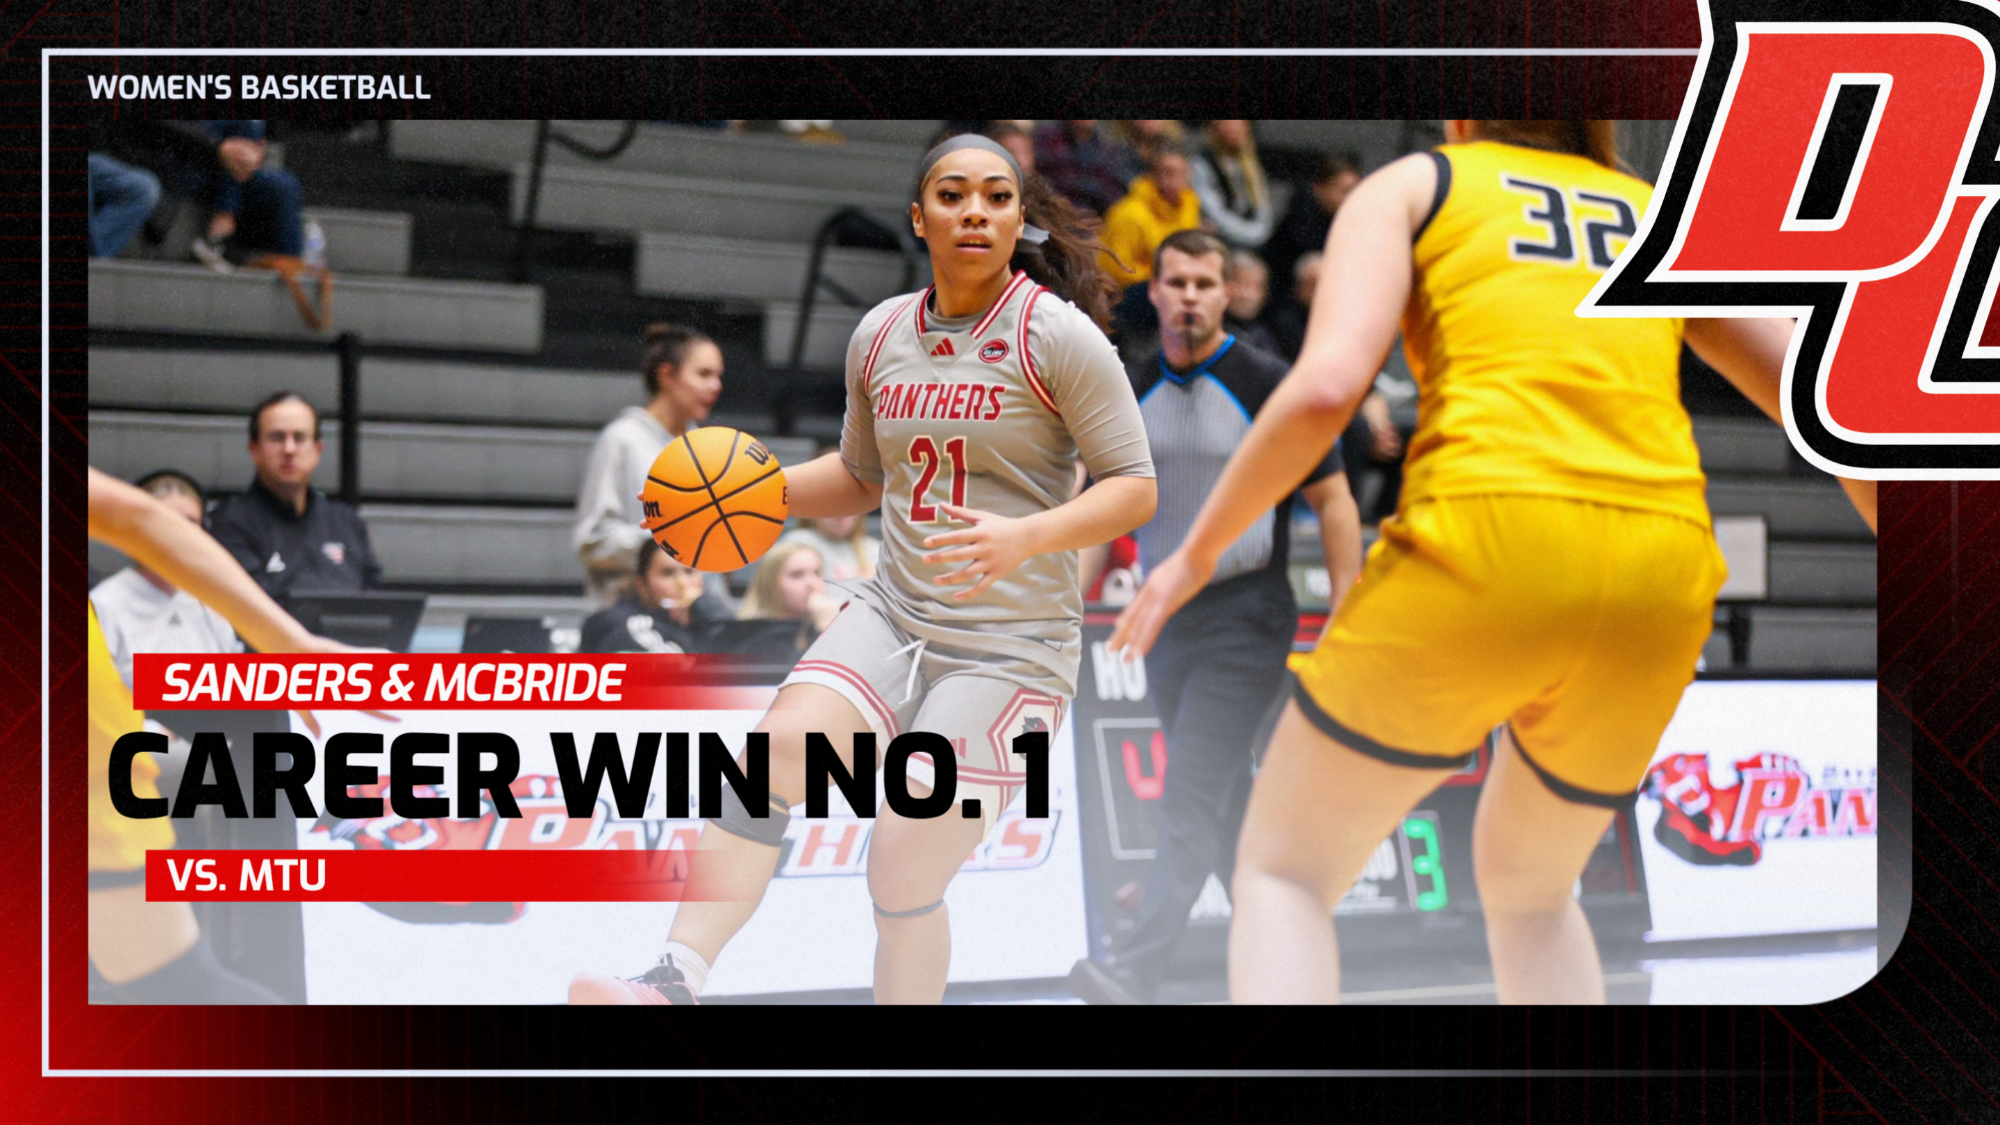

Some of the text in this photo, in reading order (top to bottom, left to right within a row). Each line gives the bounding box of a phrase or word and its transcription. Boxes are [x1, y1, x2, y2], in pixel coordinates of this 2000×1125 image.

[1500, 174, 1638, 272] 32
[876, 383, 1006, 422] PANTHERS
[908, 435, 968, 524] 21
[1402, 818, 1449, 912] 3
